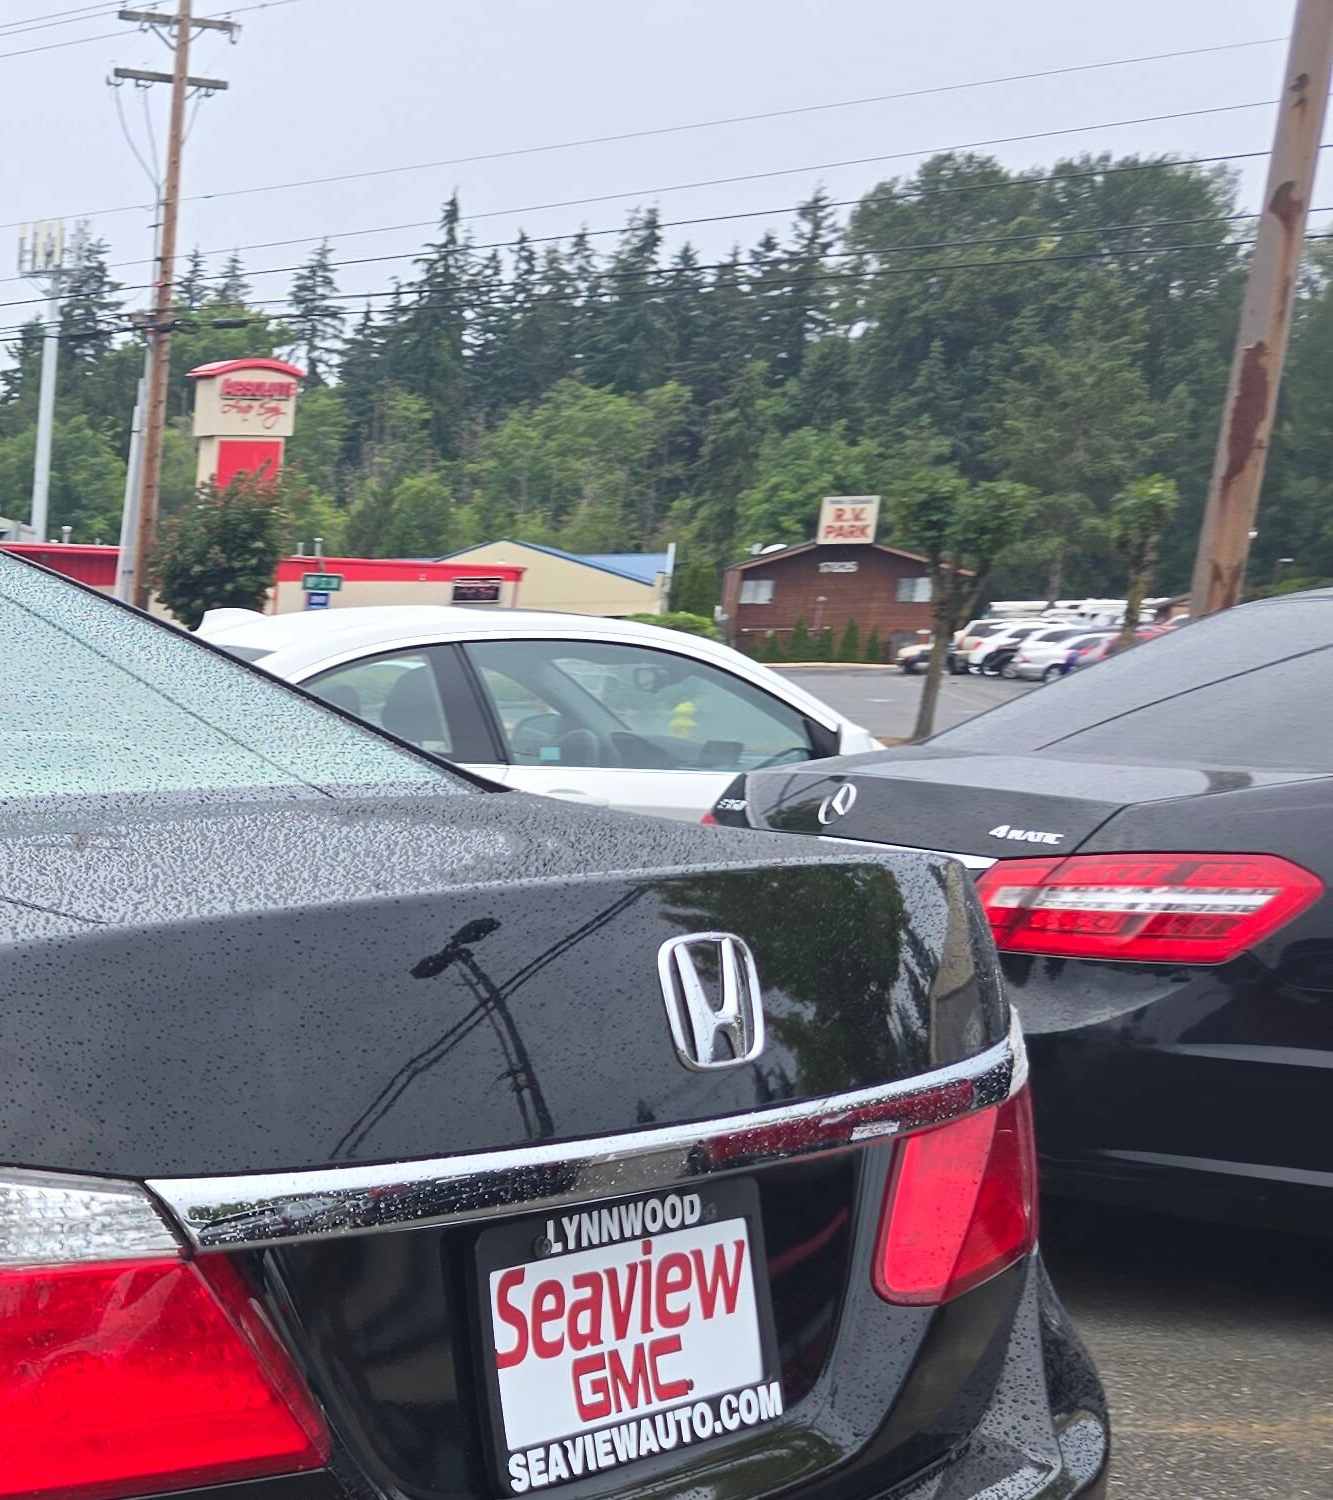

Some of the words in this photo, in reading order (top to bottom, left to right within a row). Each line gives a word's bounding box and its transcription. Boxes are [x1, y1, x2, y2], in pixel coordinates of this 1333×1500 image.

[824, 525, 871, 538] PARK
[546, 1194, 702, 1254] LYNNWOOD
[495, 1239, 745, 1370] Seaview
[572, 1334, 690, 1422] GMC
[508, 1381, 784, 1494] SEAVIEWAUTO.COM
